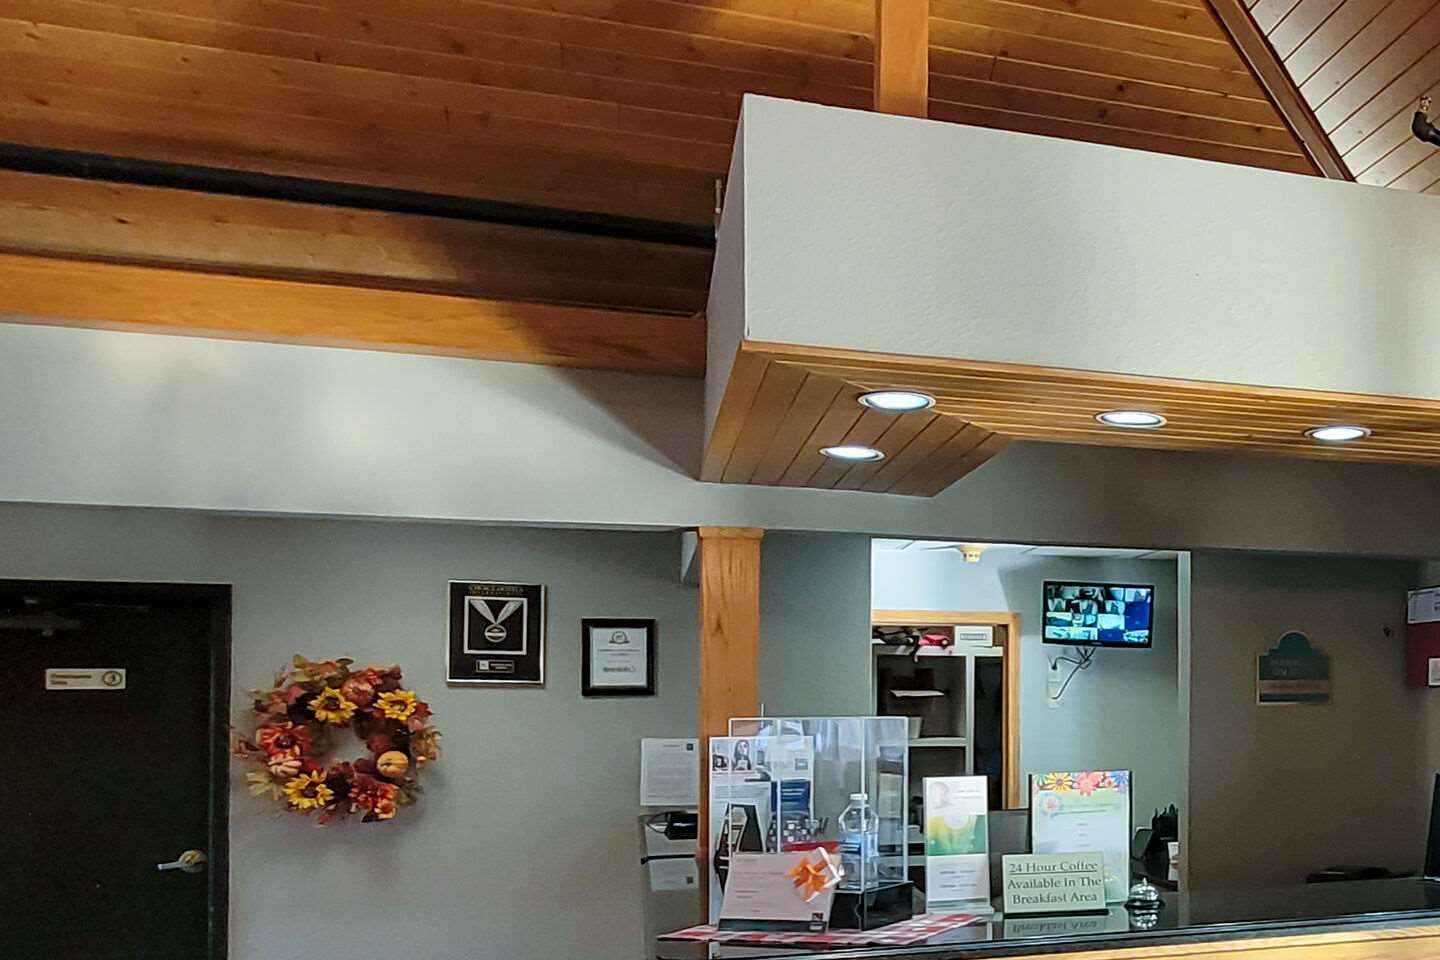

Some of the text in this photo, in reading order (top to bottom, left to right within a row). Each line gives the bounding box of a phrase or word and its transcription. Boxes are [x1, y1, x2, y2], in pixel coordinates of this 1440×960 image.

[1009, 861, 1098, 873] 24 Hour Coffee
[1008, 876, 1101, 889] Available In The
[1012, 892, 1097, 904] Breakfast Area
